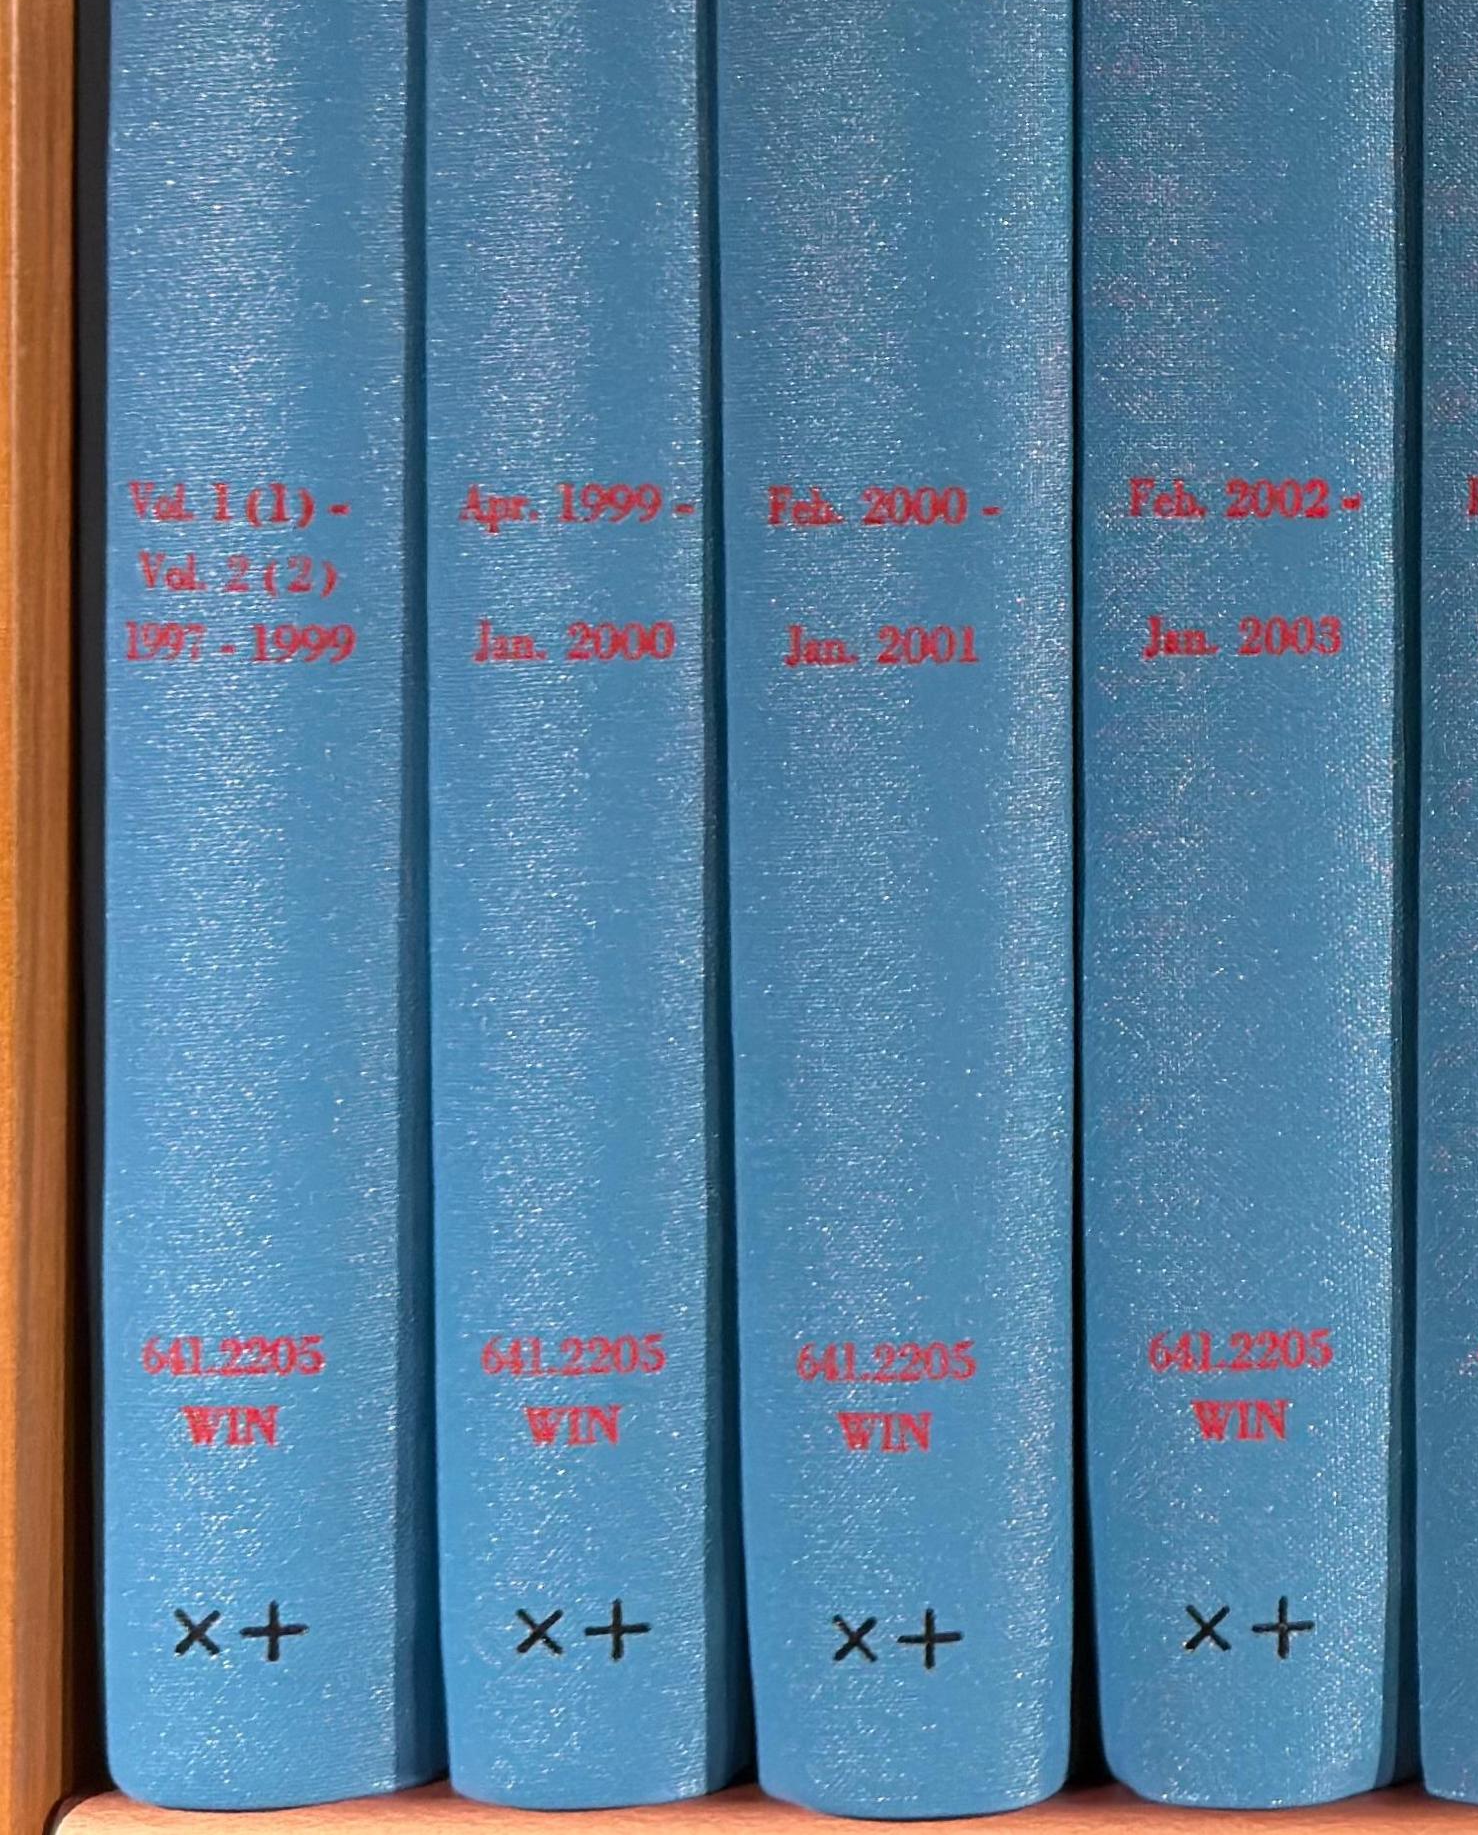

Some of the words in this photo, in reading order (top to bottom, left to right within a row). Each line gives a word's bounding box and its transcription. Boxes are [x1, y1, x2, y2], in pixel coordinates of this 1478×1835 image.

[460, 483, 539, 535] Apr.
[556, 483, 663, 523] 1999
[768, 486, 842, 527] Feb.
[862, 486, 968, 526] 2000
[1130, 477, 1206, 519] Feb.
[1225, 478, 1330, 518] 2002
[252, 624, 357, 663] 1999
[474, 617, 547, 663] Jan.
[567, 621, 676, 662] 2000
[786, 624, 858, 668] Jan.
[877, 624, 979, 665] 2001
[1143, 616, 1221, 661] Jan.
[1237, 616, 1342, 657] 2003
[143, 1335, 325, 1378] 641.2205
[482, 1335, 666, 1377] 641.2205
[798, 1342, 977, 1384] 641.2205
[1149, 1330, 1334, 1374] 641.2205
[183, 1405, 279, 1447] WIN
[526, 1406, 621, 1447] WIN
[838, 1412, 932, 1454] WIN
[1192, 1400, 1288, 1442] WIN
